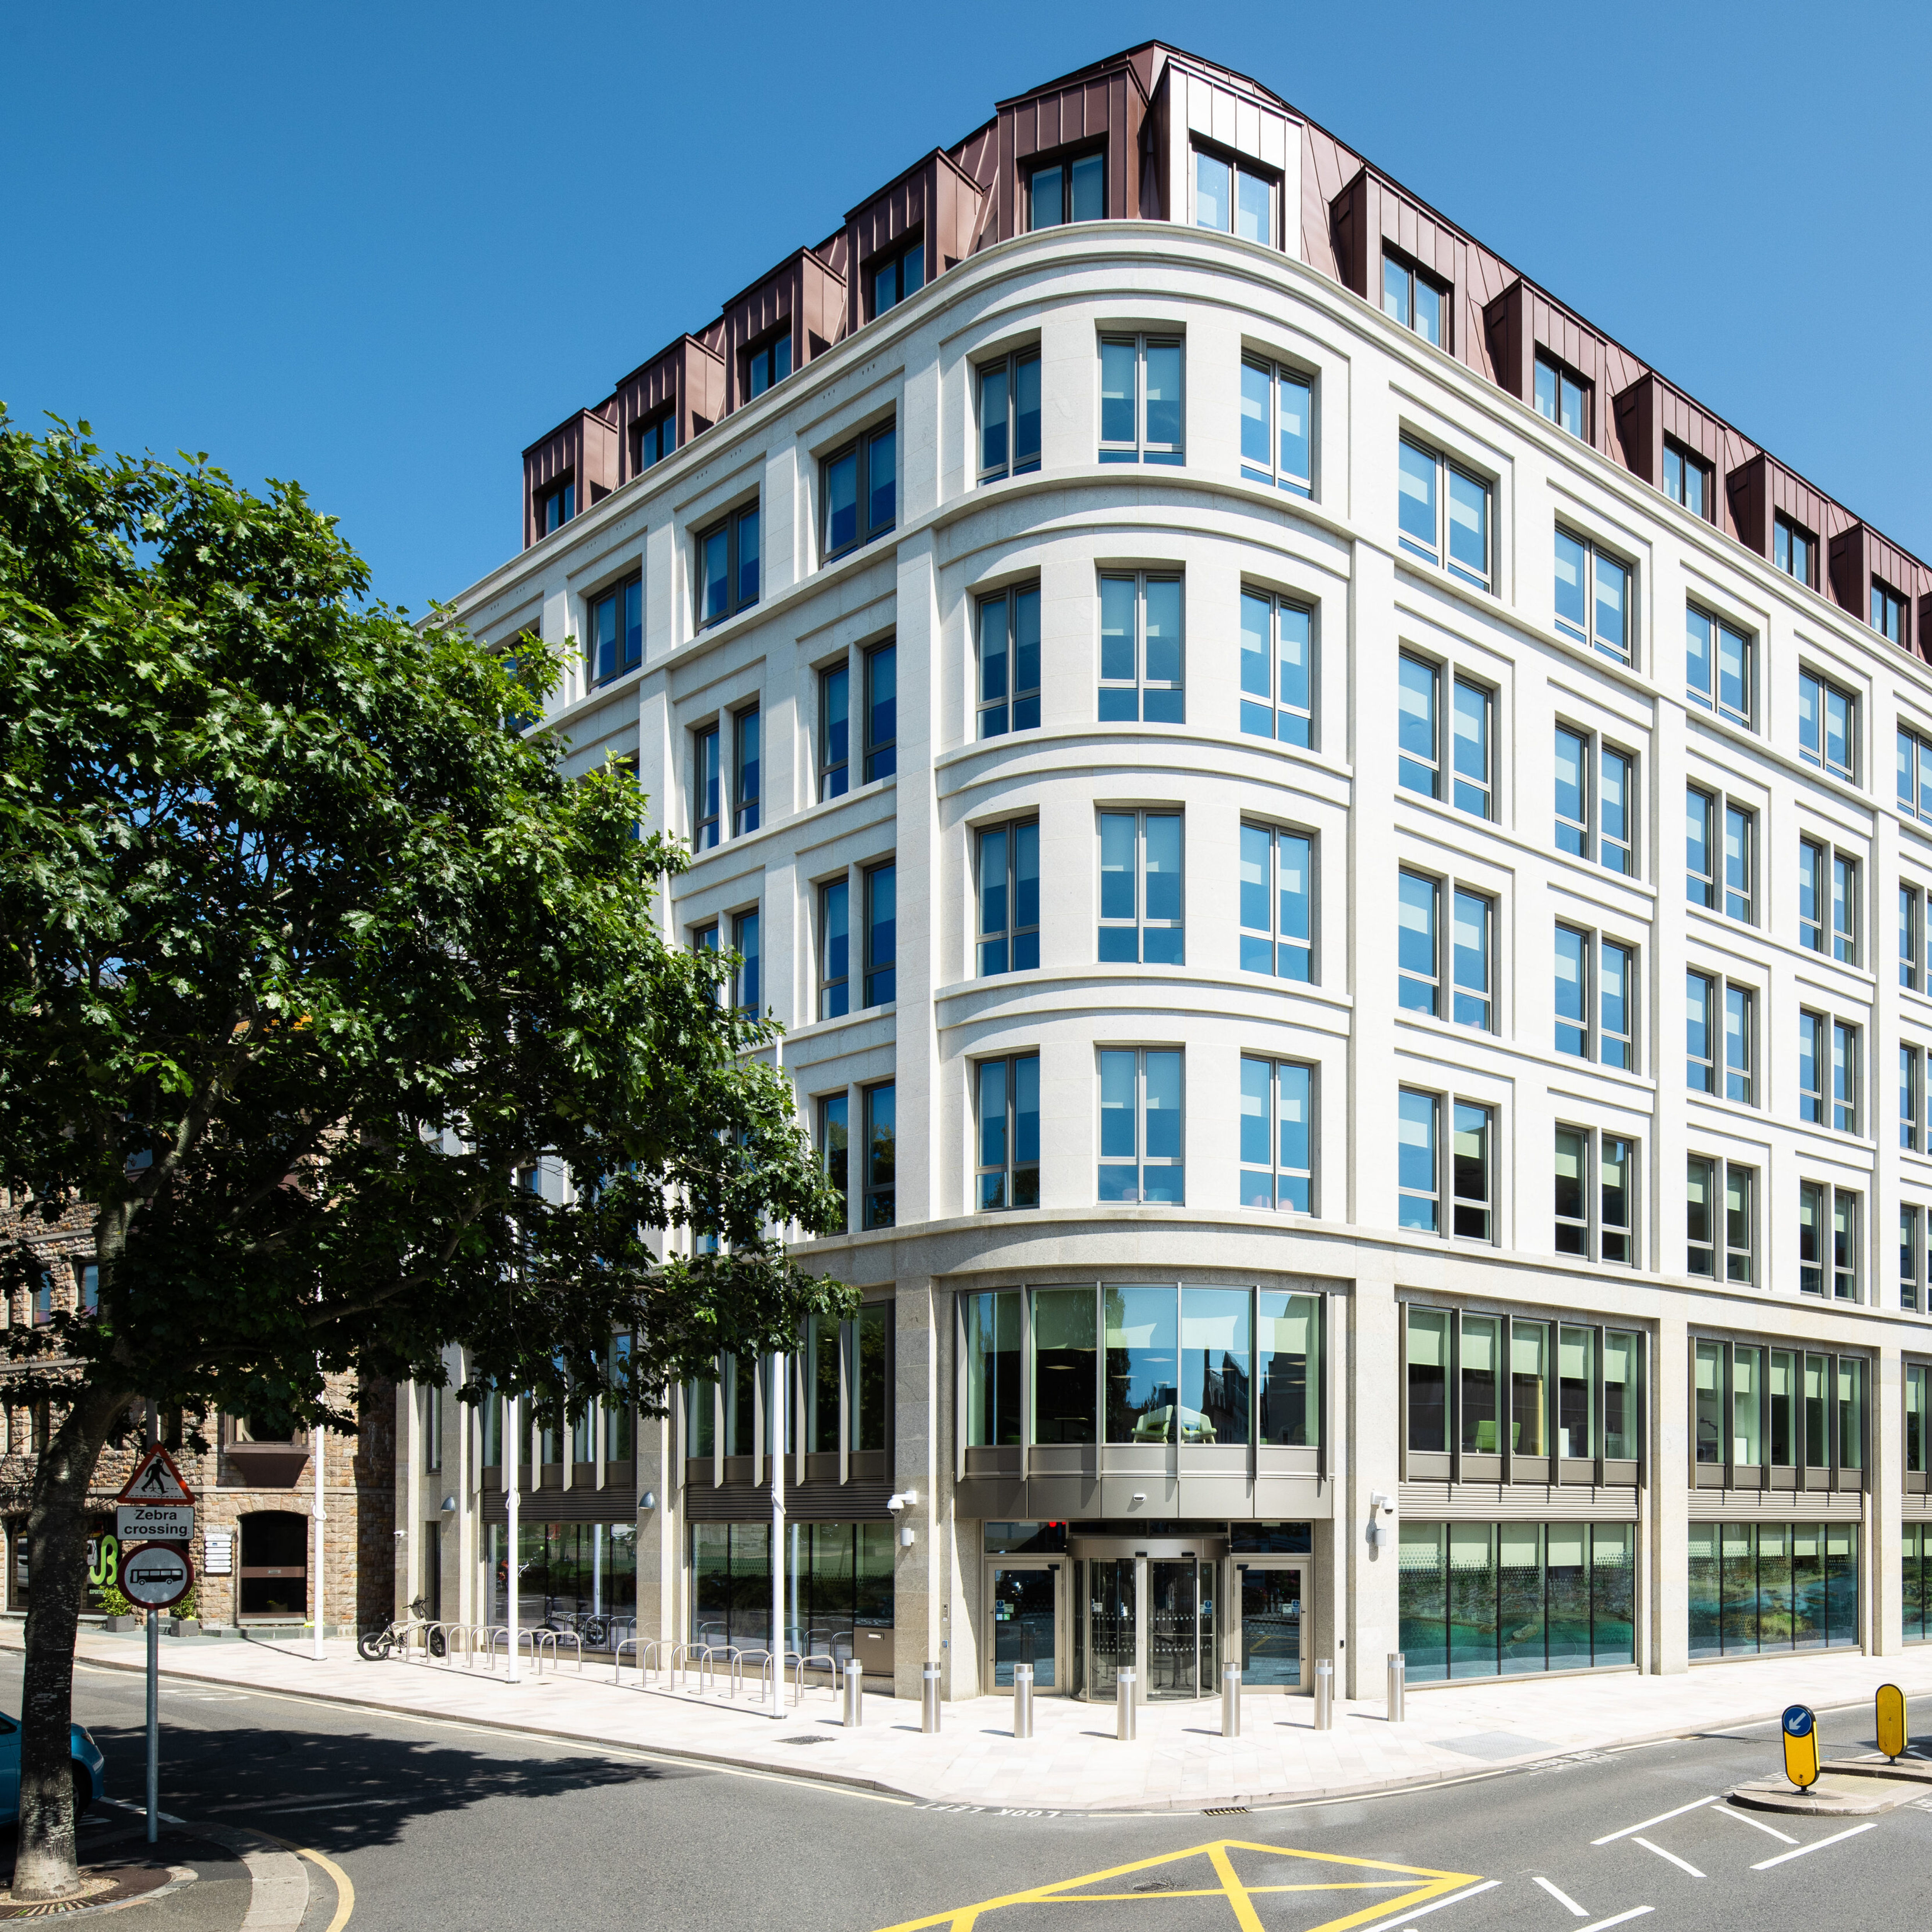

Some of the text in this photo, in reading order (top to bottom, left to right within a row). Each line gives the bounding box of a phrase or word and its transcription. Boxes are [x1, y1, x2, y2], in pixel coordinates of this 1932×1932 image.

[135, 1509, 177, 1520] Zebra
[124, 1524, 187, 1536] crossing
[913, 1803, 1061, 1818] LOOK LEFT
